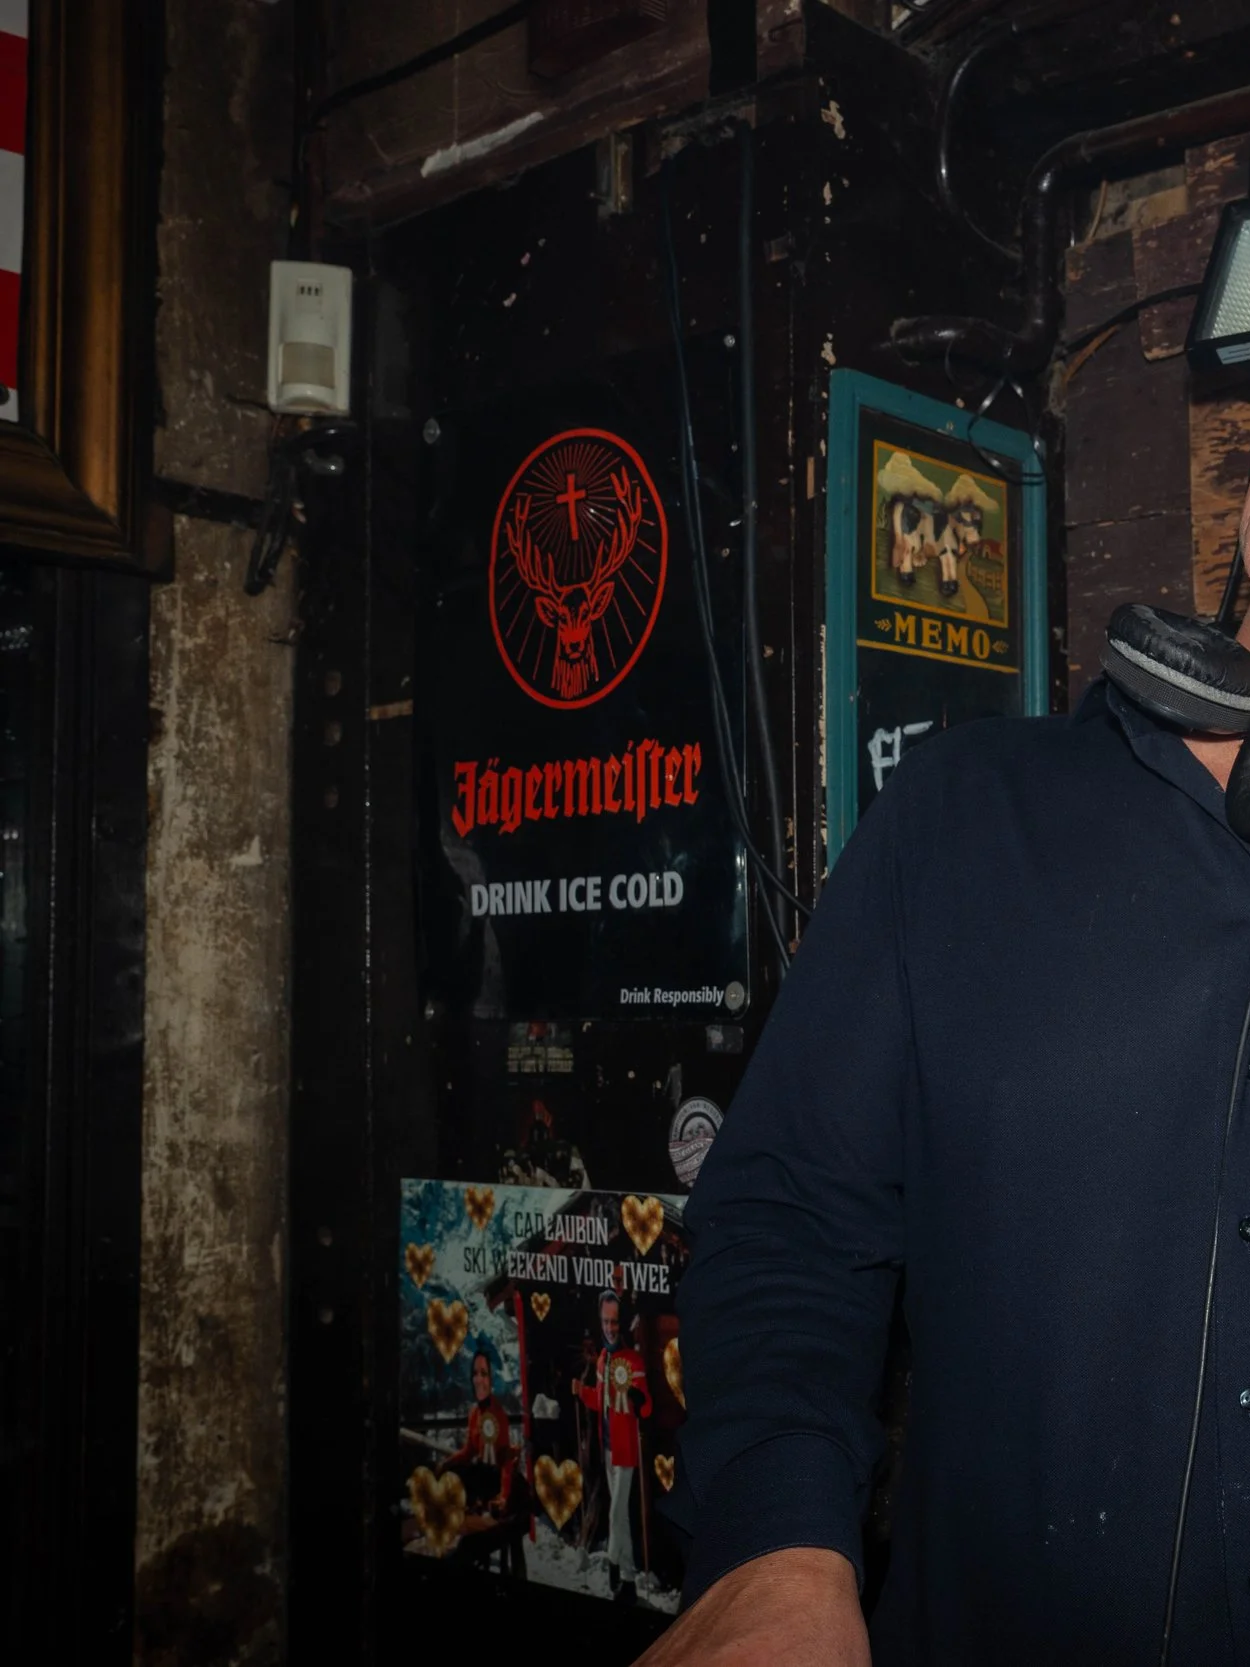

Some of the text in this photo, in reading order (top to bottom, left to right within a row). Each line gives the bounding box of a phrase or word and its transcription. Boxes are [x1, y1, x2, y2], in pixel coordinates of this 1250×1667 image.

[894, 612, 992, 660] MEMO
[452, 738, 702, 838] Jägermeister
[471, 871, 684, 916] DRINK ICE COLD
[620, 986, 724, 1007] Drink Responsibly
[514, 1211, 609, 1246] CADEAUBON
[463, 1247, 671, 1294] SKI WEEKEND VOOR TWEE
